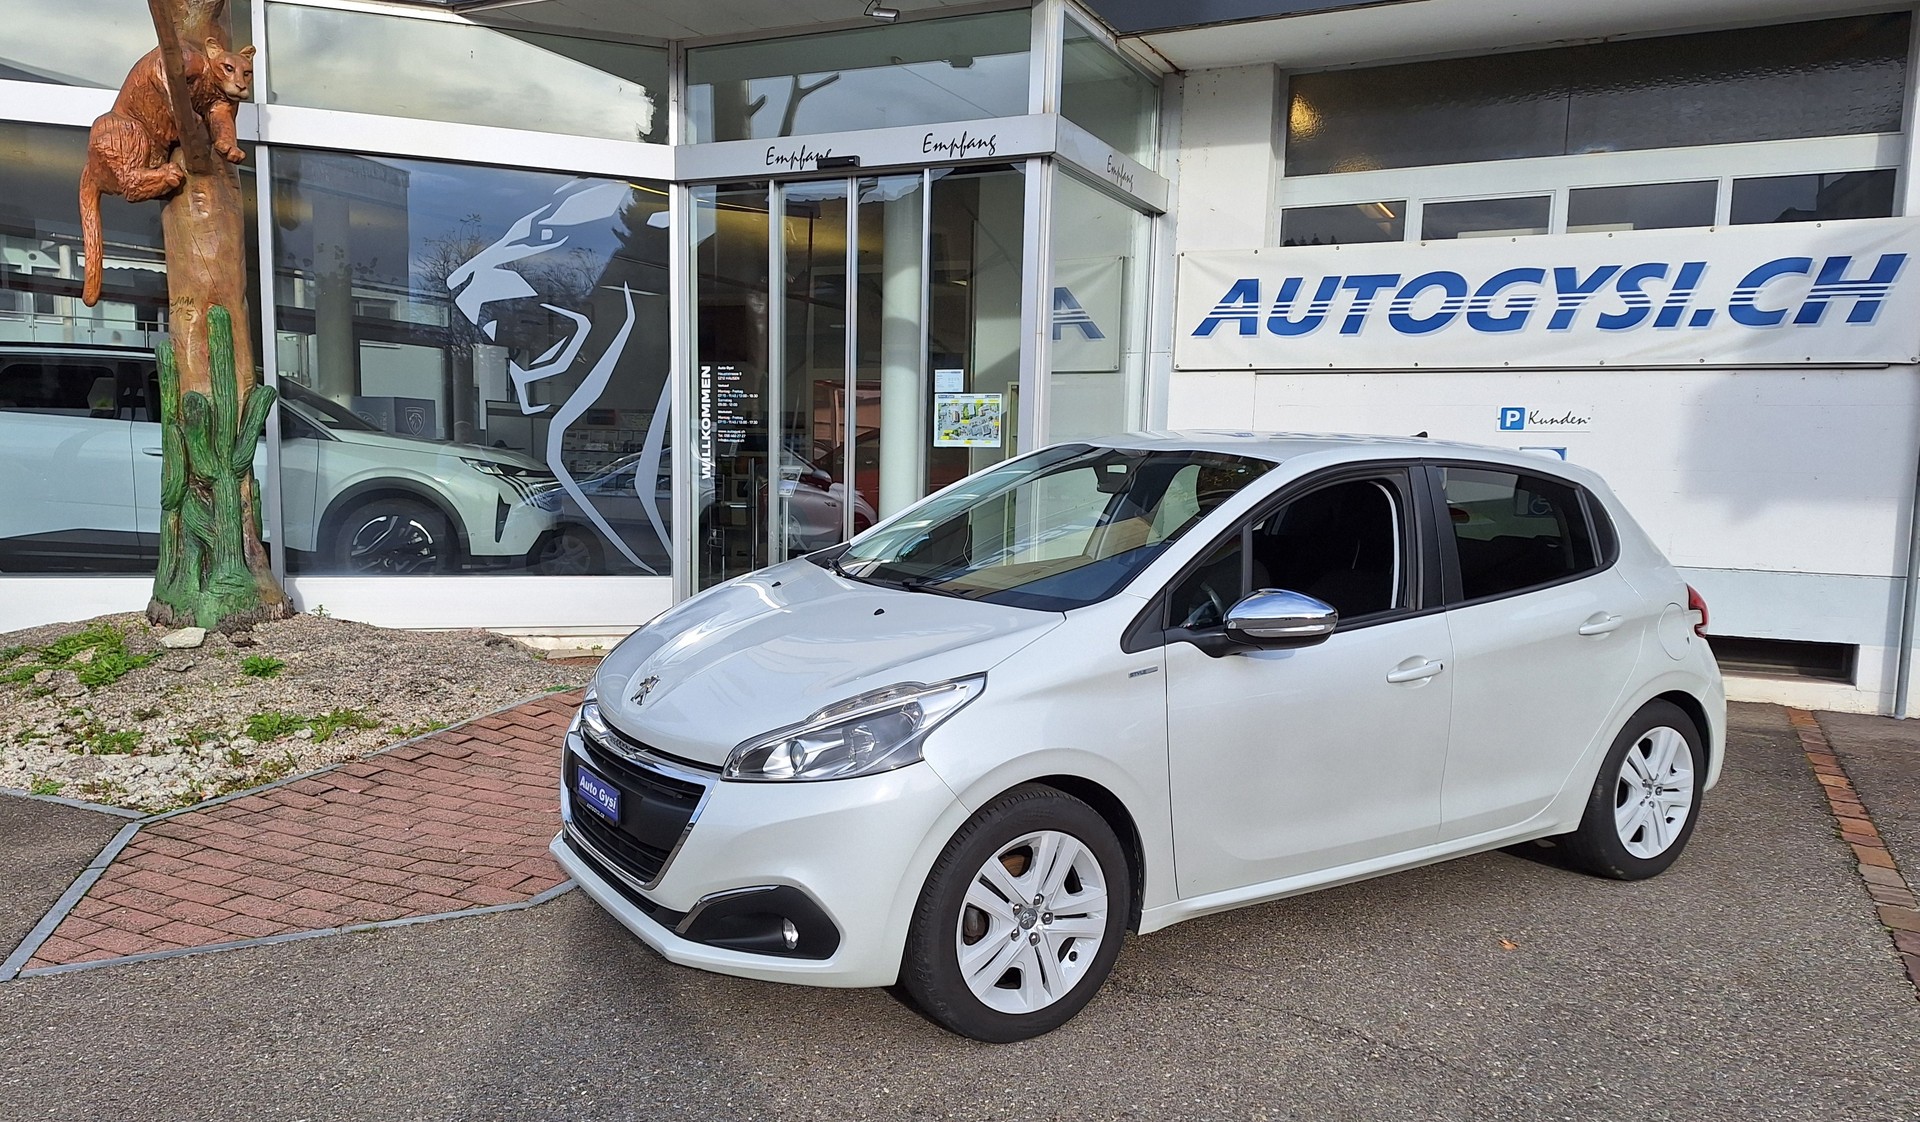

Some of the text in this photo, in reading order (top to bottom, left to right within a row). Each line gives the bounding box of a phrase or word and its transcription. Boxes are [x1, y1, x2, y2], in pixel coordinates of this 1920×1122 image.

[923, 131, 997, 158] Empfang
[1107, 154, 1134, 192] Empfang
[1191, 253, 1908, 337] AUTOGYSI.CH
[701, 366, 711, 480] WILLKOMMEN
[1505, 410, 1588, 427] P Kunden
[580, 776, 617, 810] Auto Gysi
